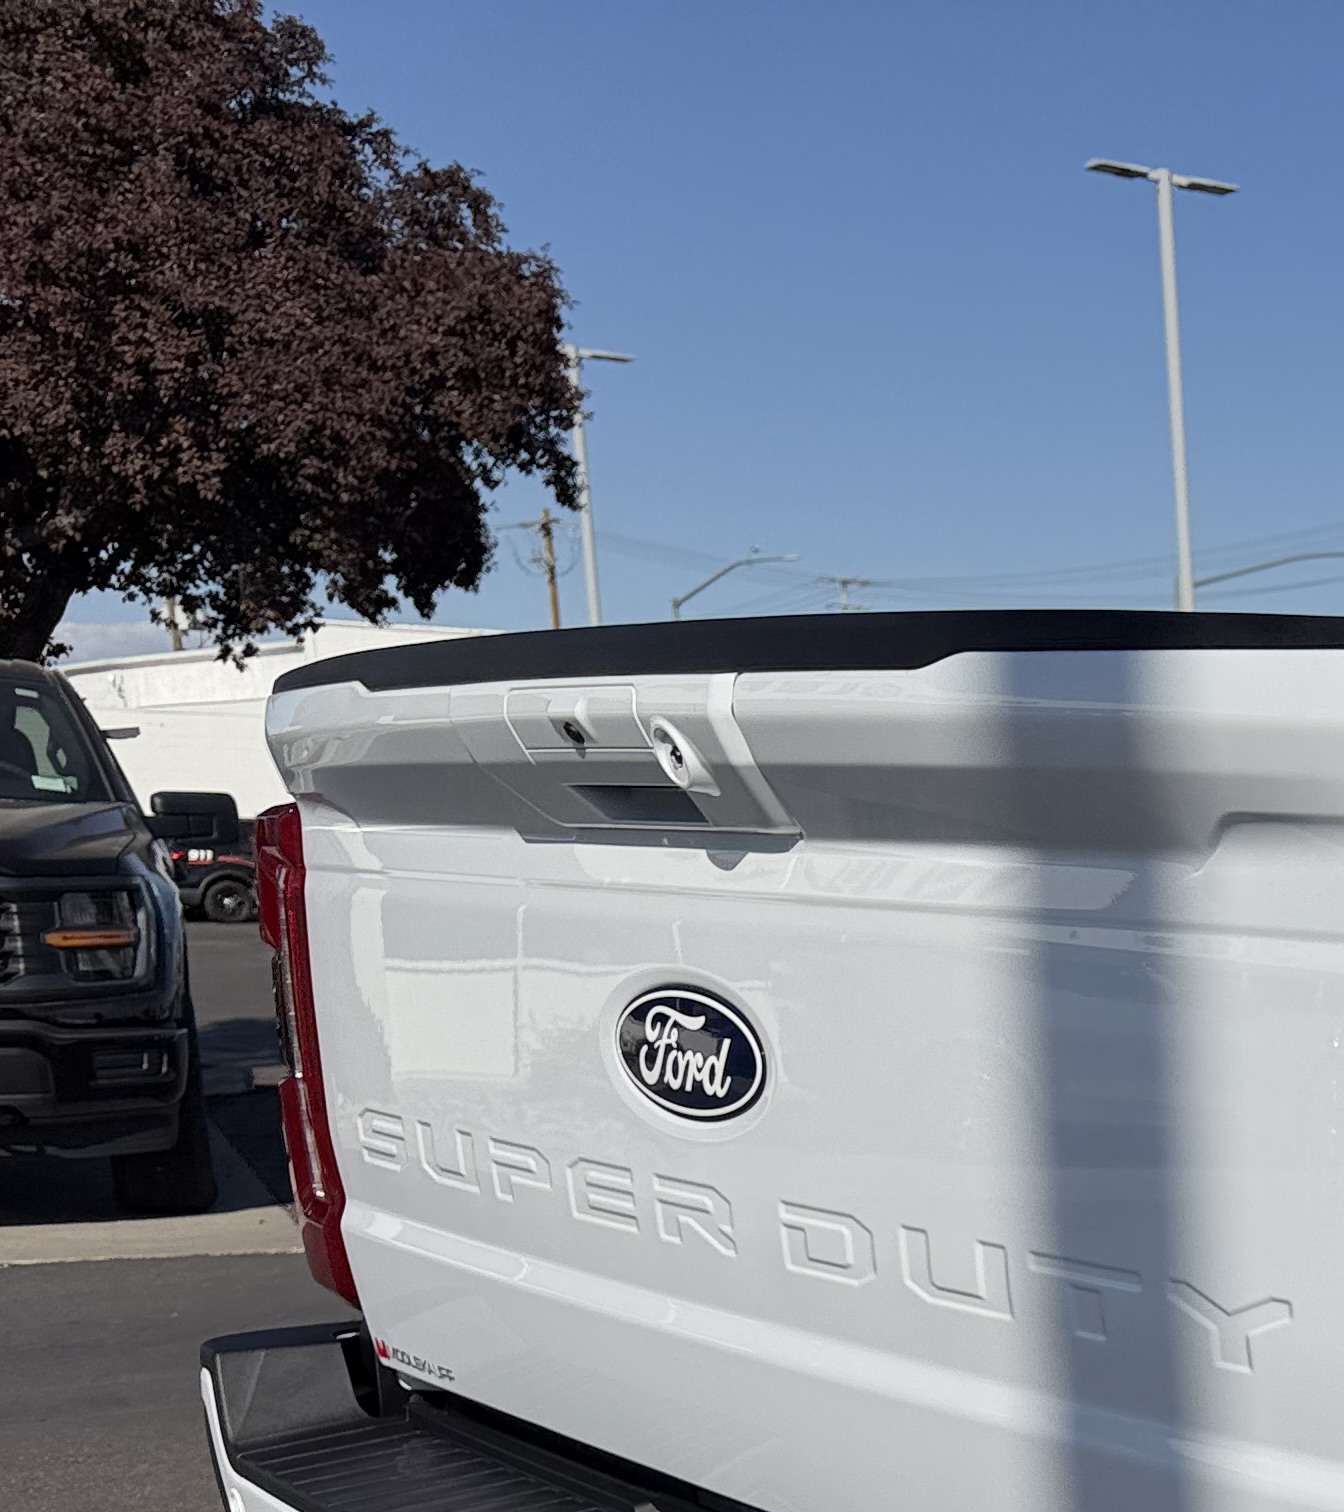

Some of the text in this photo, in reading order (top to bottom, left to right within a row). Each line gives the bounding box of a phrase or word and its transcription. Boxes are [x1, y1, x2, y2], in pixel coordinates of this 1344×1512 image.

[639, 1004, 732, 1098] Ford
[357, 1106, 1294, 1374] SUPER DUTY
